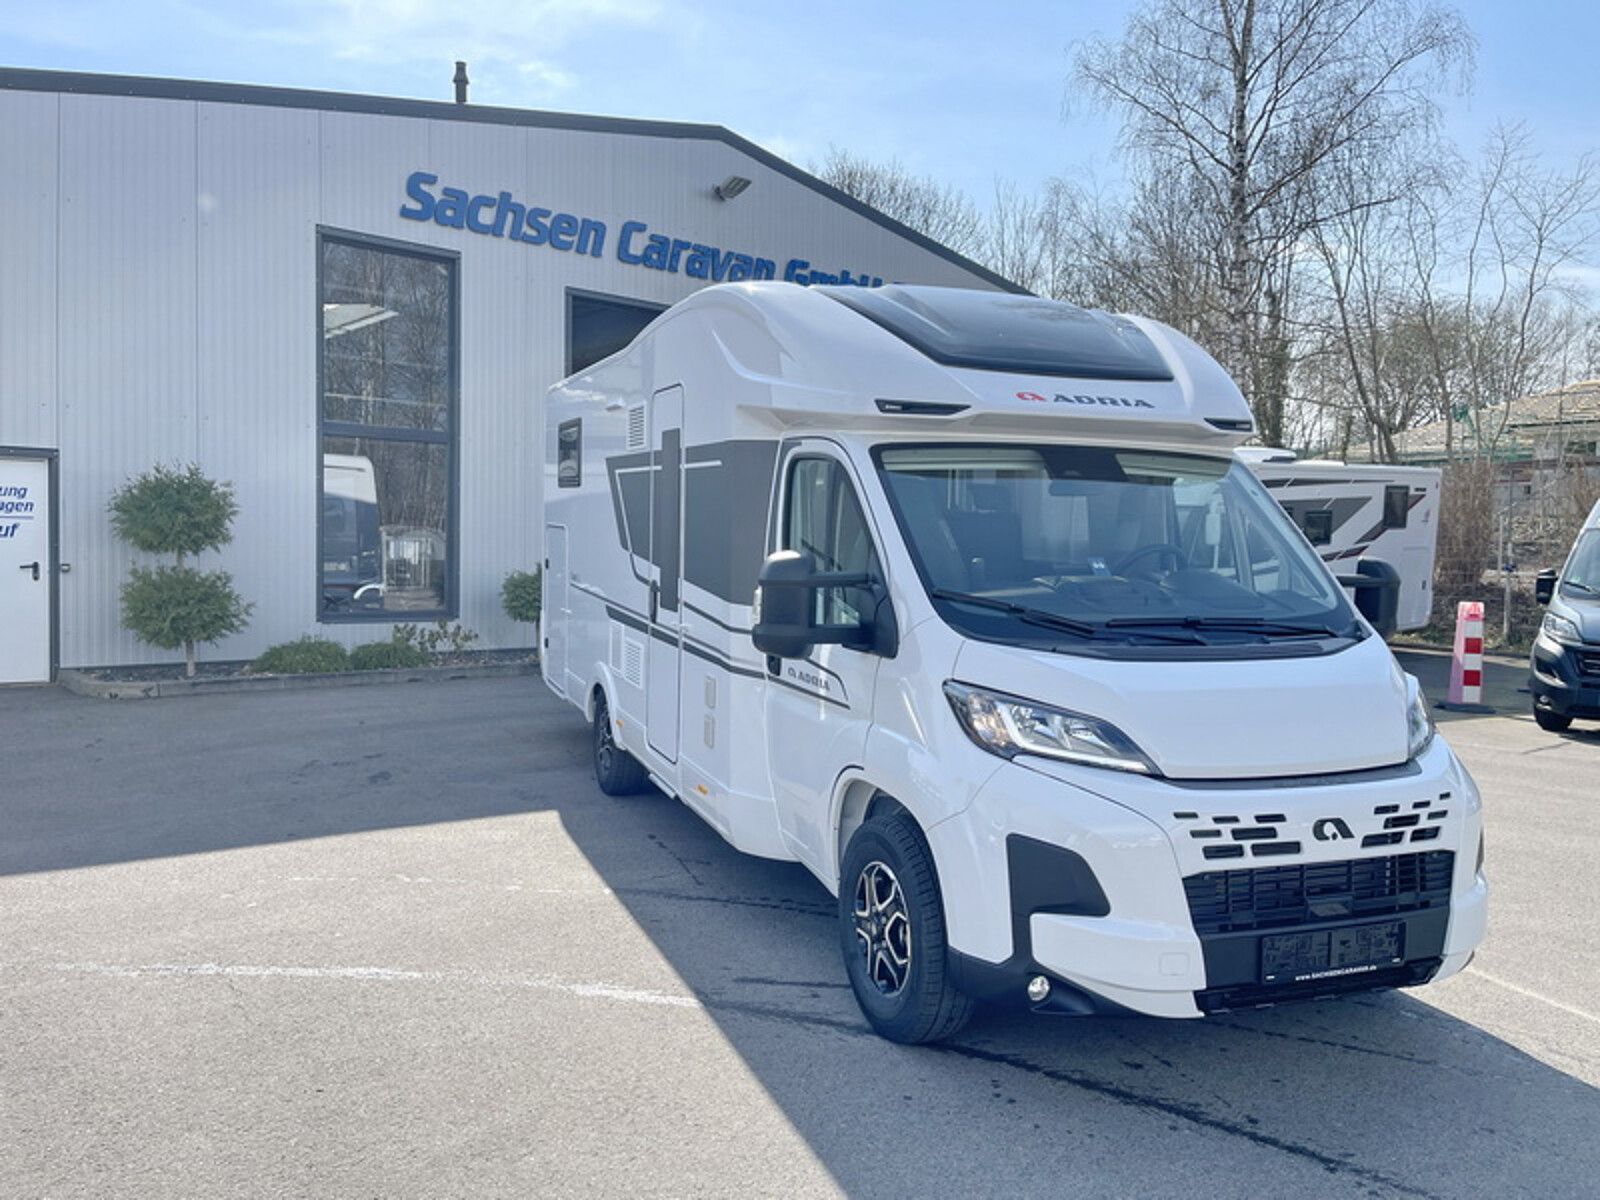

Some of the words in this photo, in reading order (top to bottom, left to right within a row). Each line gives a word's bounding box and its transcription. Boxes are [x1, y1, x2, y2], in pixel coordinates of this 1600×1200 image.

[401, 172, 606, 257] Sachsen
[617, 220, 776, 282] Caravan
[1053, 394, 1155, 408] ADRIA
[797, 671, 830, 690] ADRIA
